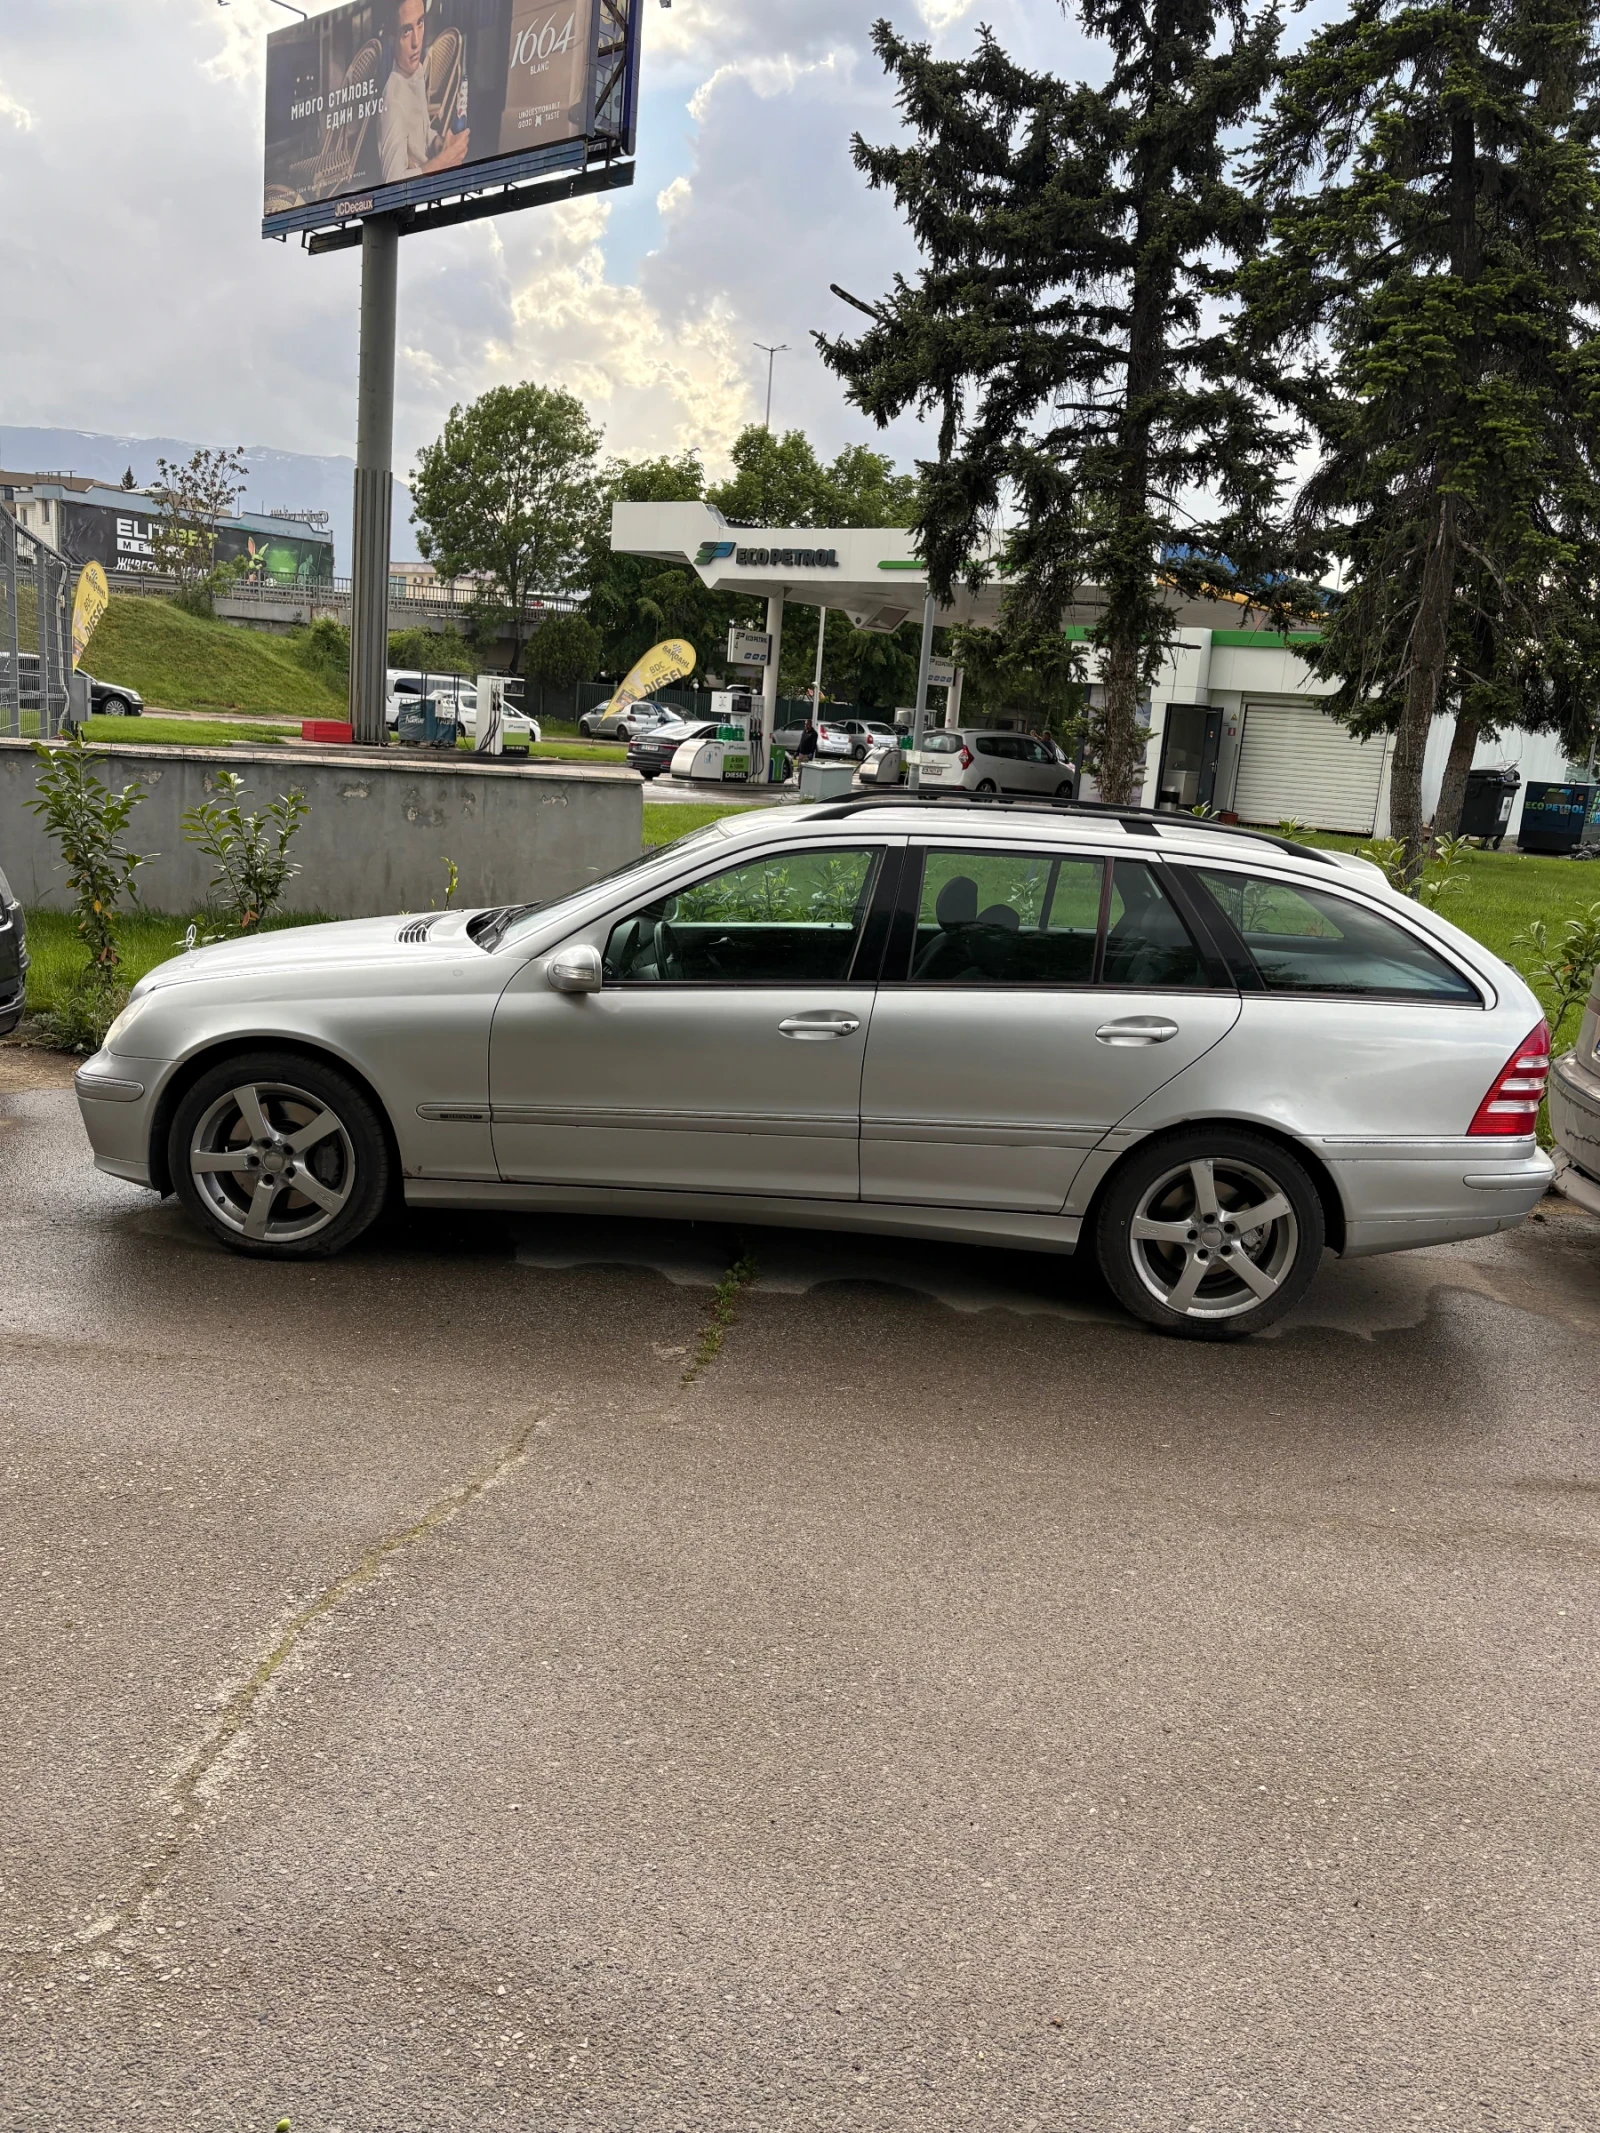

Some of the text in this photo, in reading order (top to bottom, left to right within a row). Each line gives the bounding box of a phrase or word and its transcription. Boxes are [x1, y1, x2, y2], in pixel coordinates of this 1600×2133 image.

[510, 12, 576, 69] 1664
[530, 61, 550, 76] BLANC
[291, 78, 378, 121] МНОГО СТИЛОВЕ.
[326, 97, 388, 131] ЕДИН ВКУС.
[518, 101, 561, 119] UNQUESTIONABLY
[518, 111, 560, 129] GOOD TASTE
[335, 199, 374, 217] JCDecaux
[736, 547, 839, 567] ECOPETROL
[662, 645, 690, 669] BARDAHL
[649, 660, 666, 674] BDC
[643, 667, 683, 694] DIESEL
[725, 771, 747, 779] DIESEL
